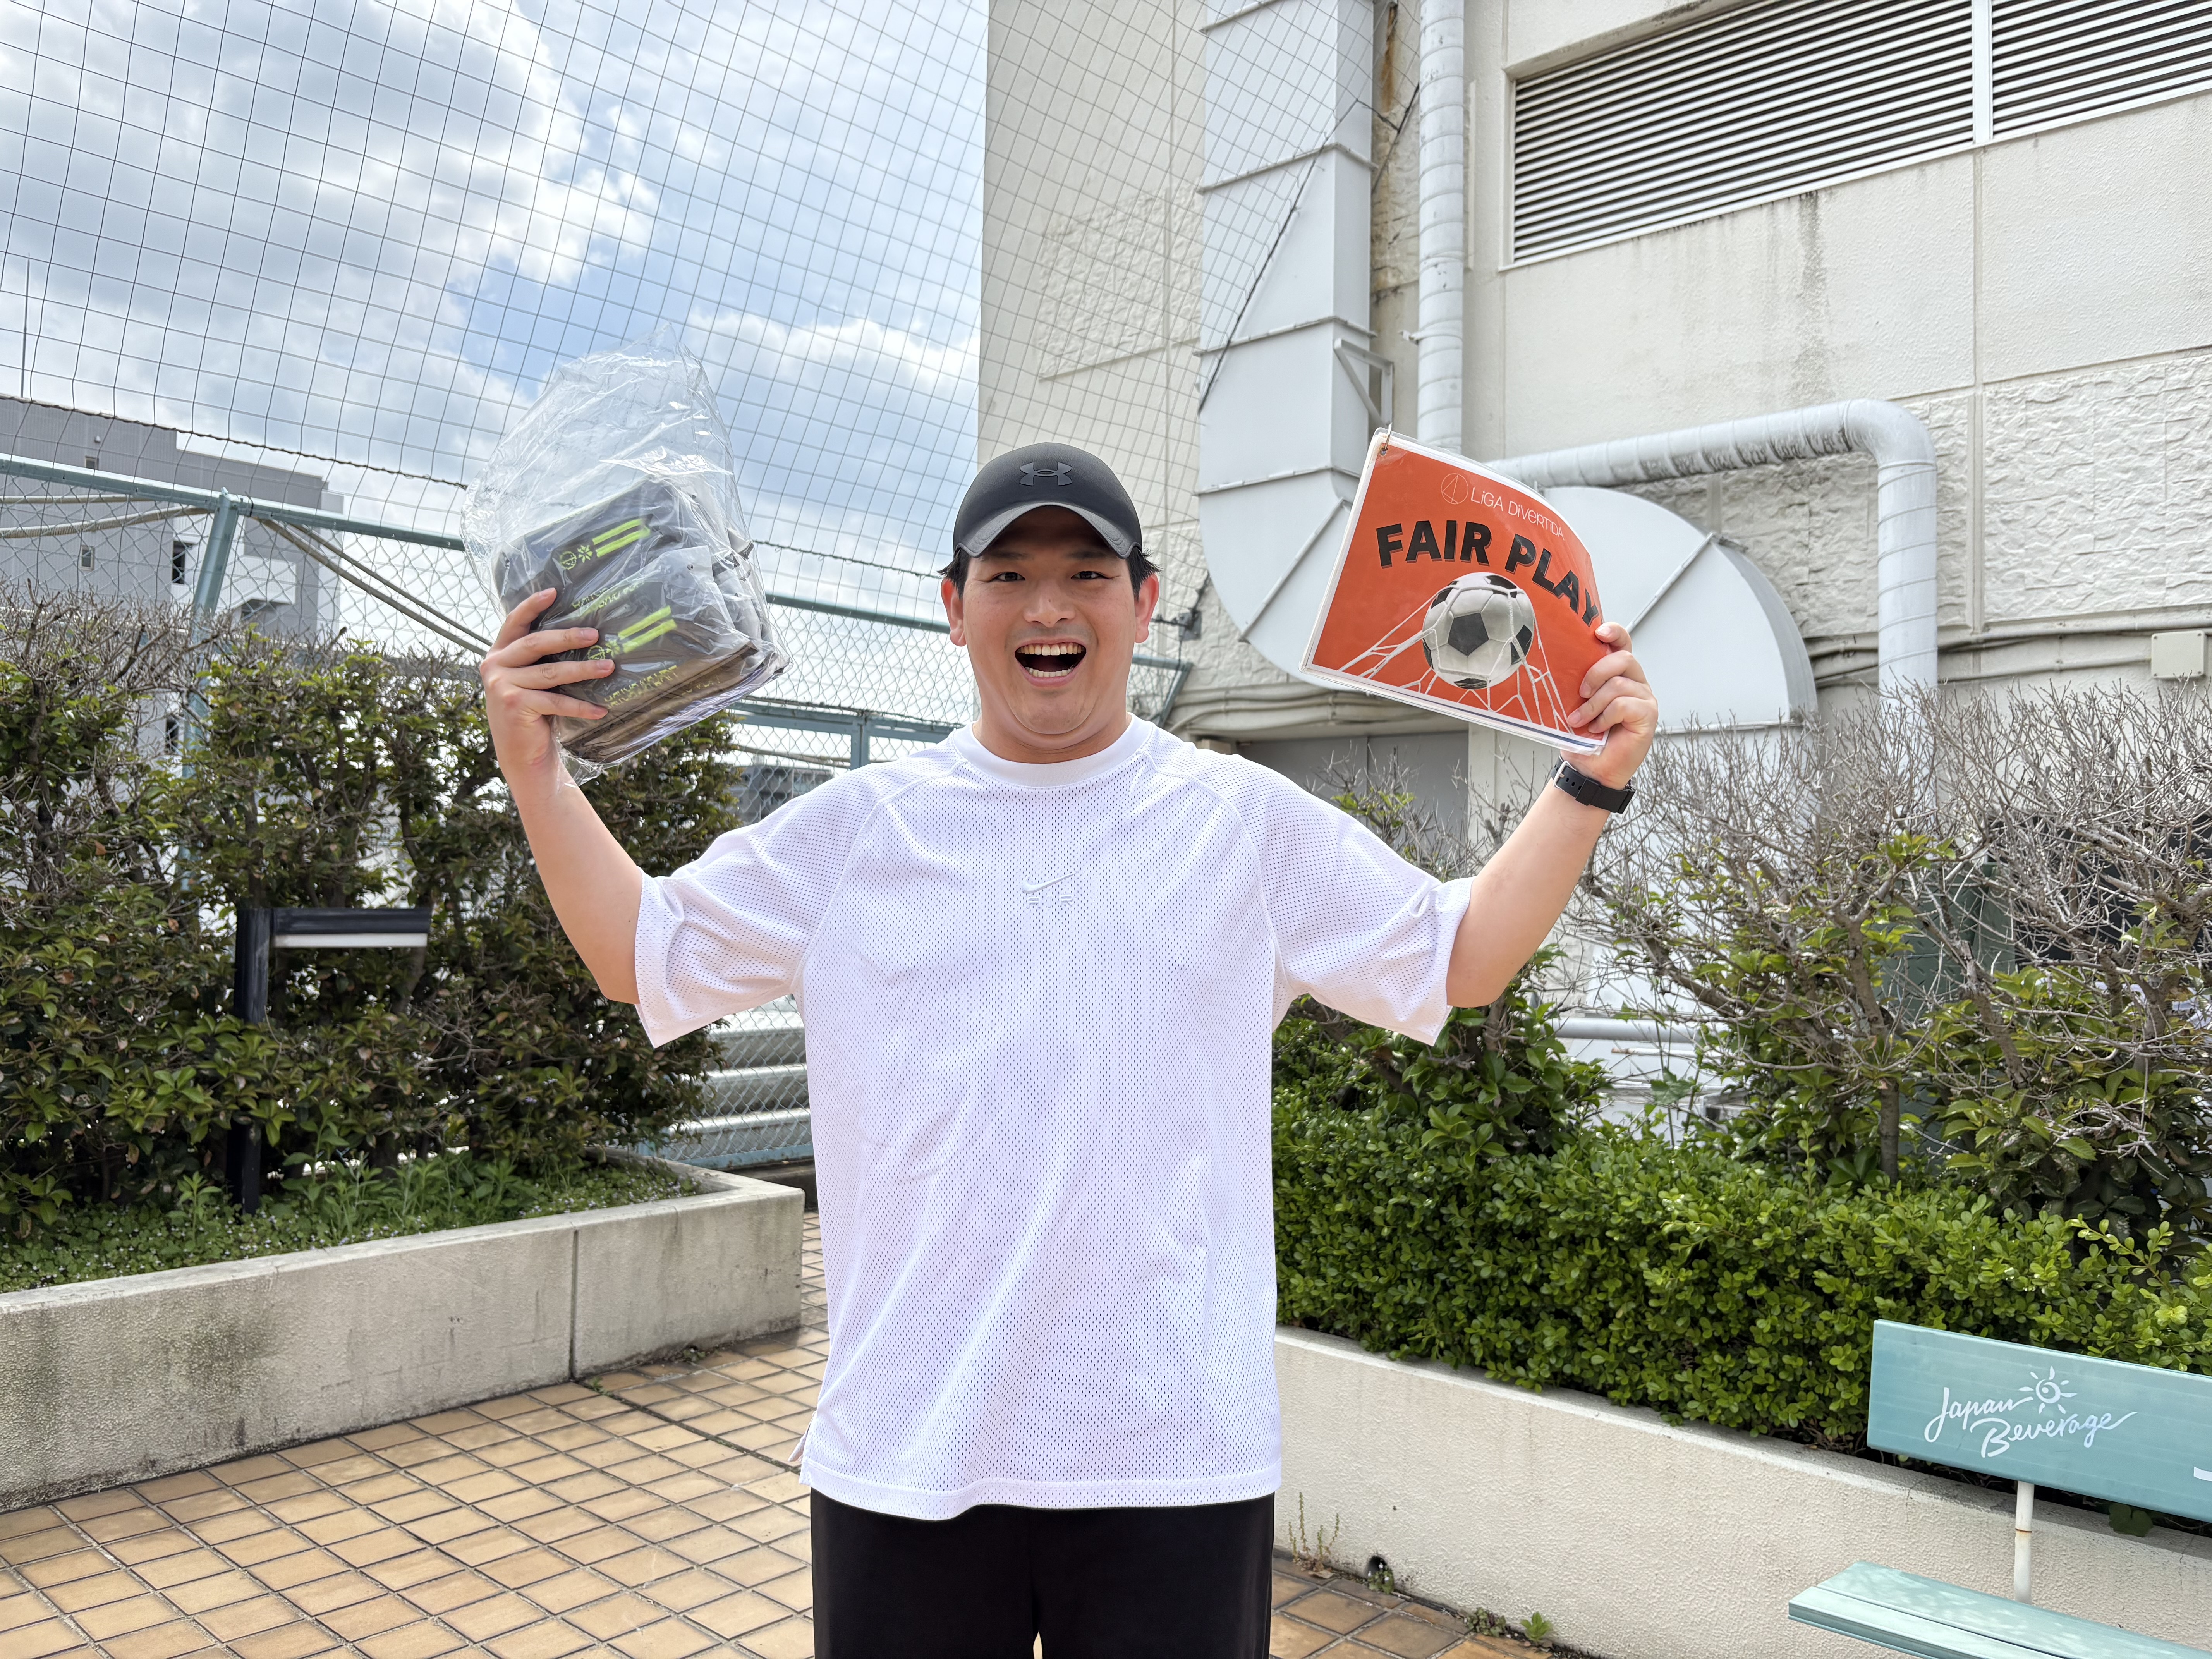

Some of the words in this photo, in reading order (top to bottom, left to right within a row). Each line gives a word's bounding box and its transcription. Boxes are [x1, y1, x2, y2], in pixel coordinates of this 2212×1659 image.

[1376, 520, 1492, 568] FAIR
[1504, 533, 1599, 627] PLAY
[1026, 894, 1073, 909] AIR
[1924, 1387, 2033, 1443] Japan
[1970, 1412, 2138, 1458] Beverage
